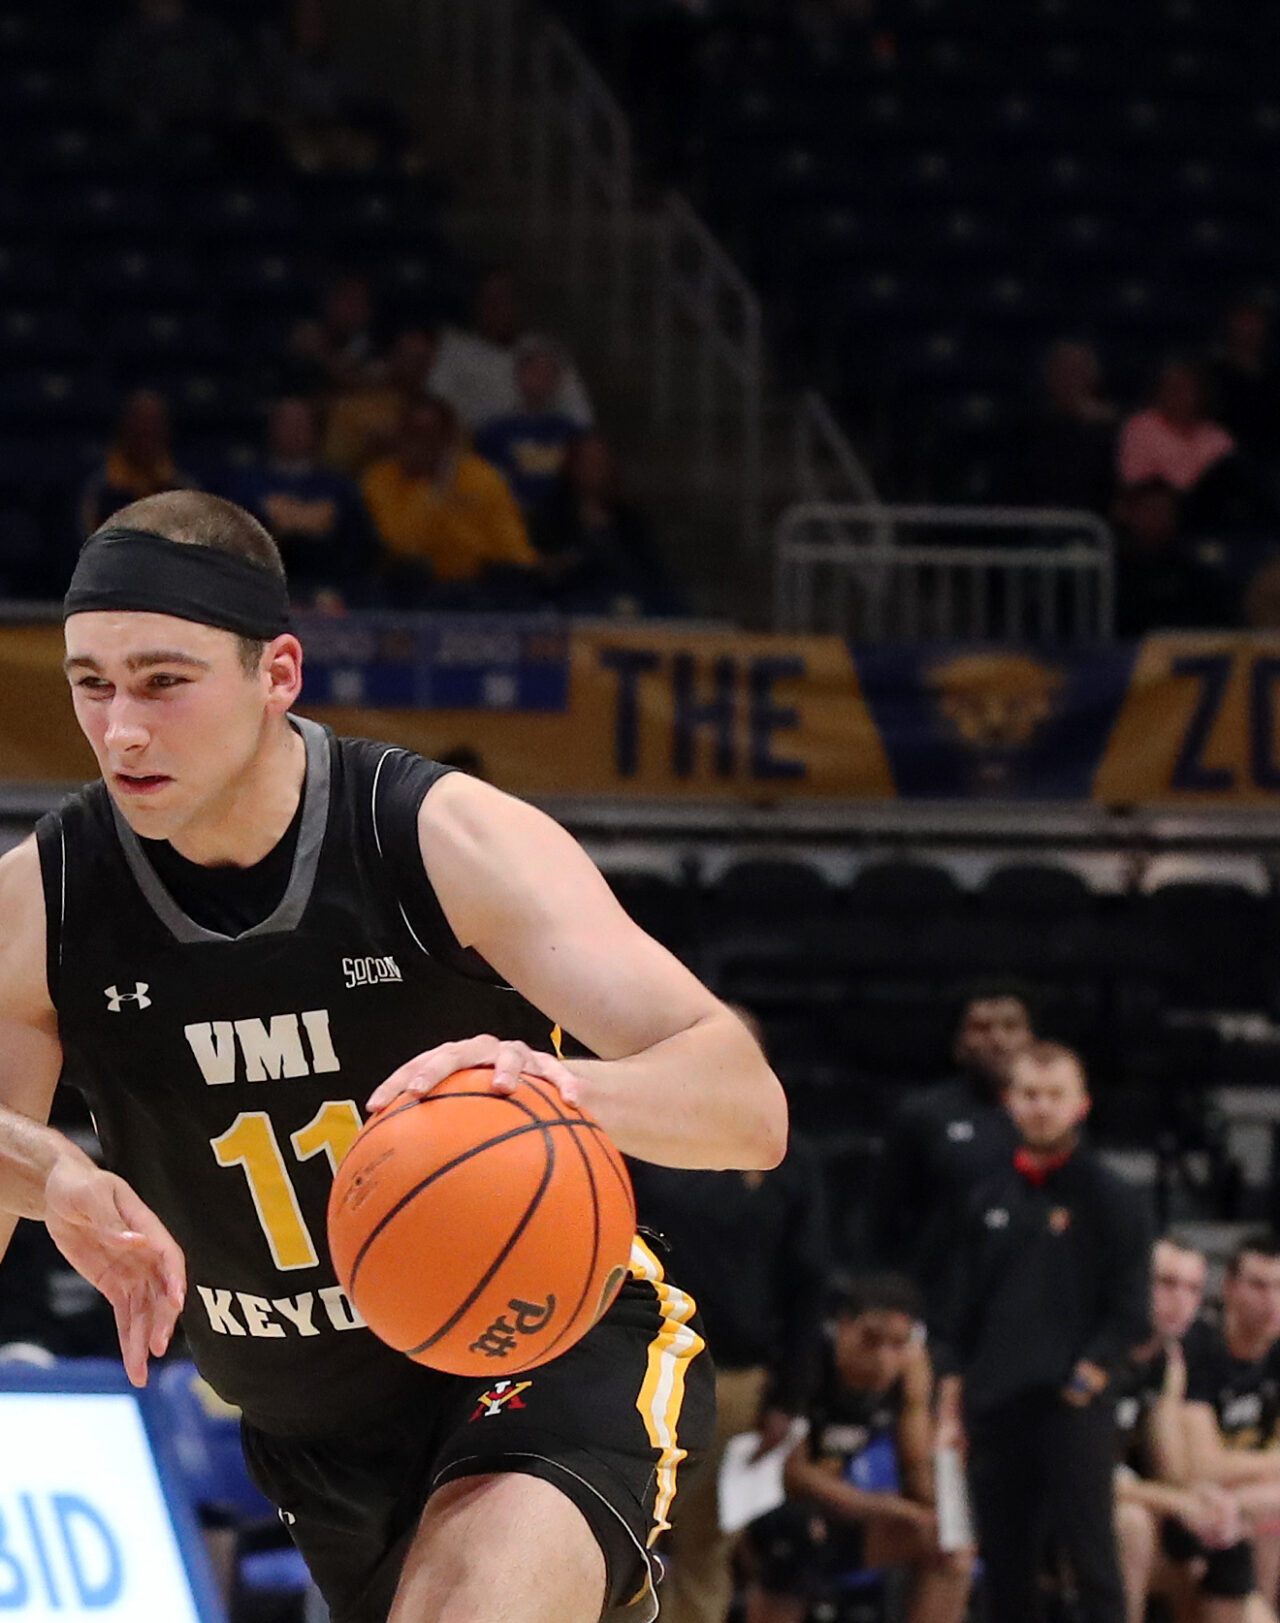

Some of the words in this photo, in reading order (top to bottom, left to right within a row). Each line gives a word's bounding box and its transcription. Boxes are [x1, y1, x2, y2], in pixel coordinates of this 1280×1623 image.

[599, 646, 814, 779] THE
[184, 1009, 341, 1086] VMI
[469, 1293, 556, 1358] Pitt
